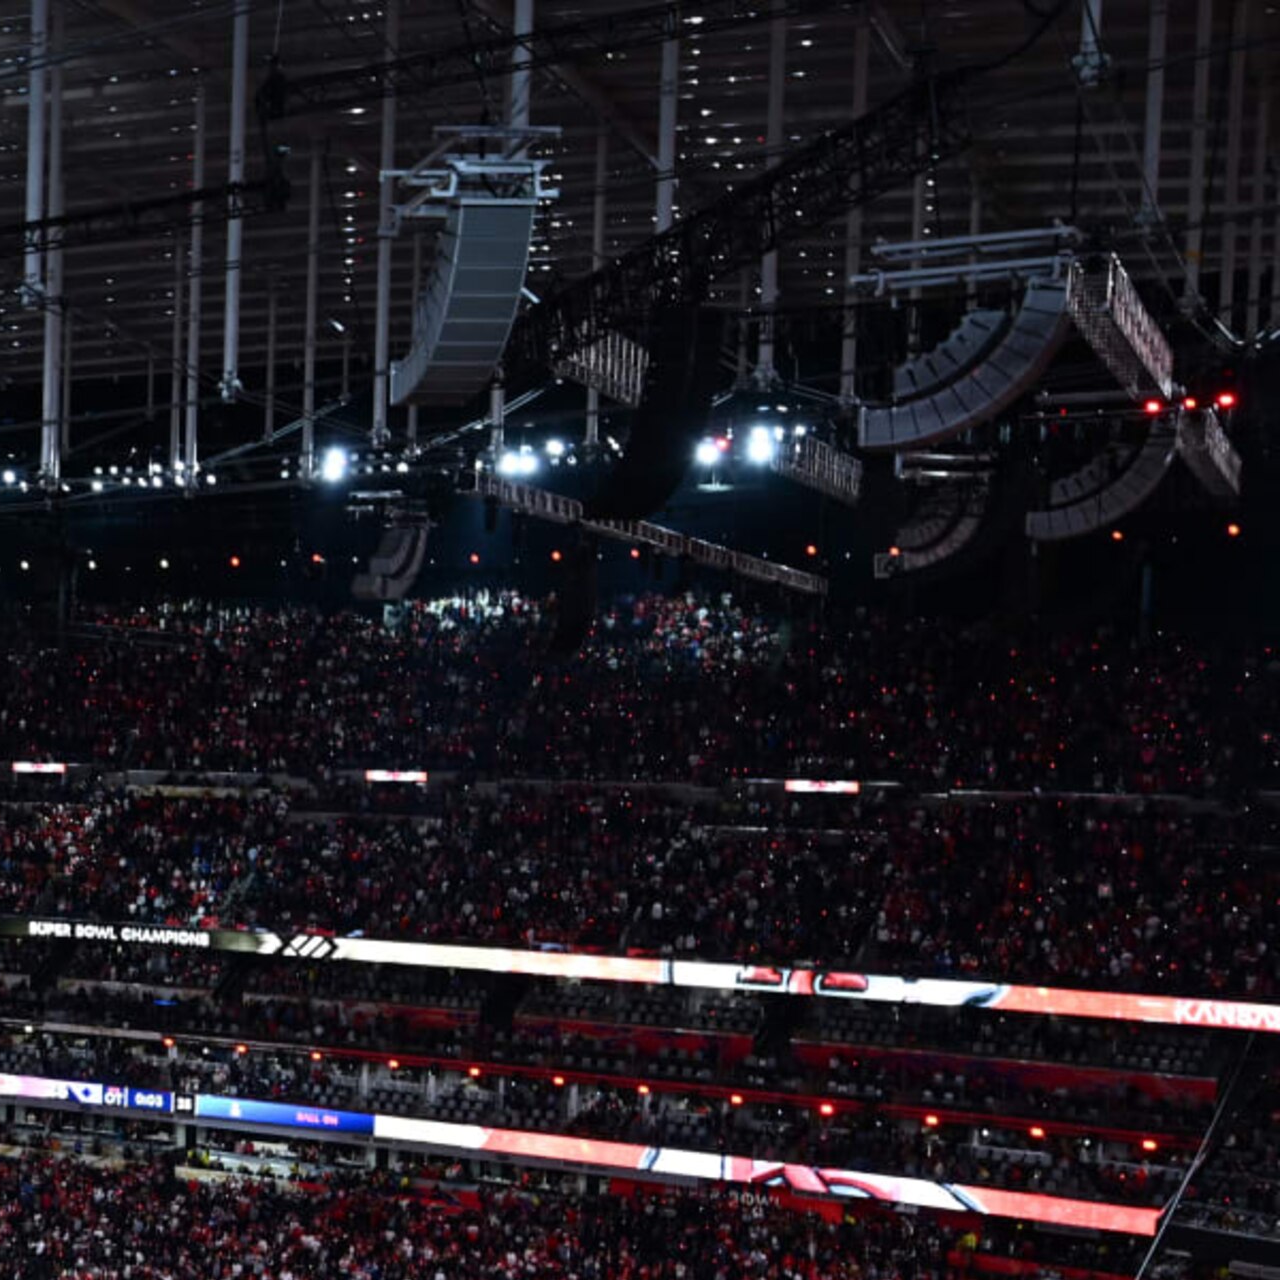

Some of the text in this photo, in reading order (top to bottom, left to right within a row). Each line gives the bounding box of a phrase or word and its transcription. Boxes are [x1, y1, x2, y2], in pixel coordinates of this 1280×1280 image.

[29, 920, 210, 948] SUPER BOWL CHAMPIONS
